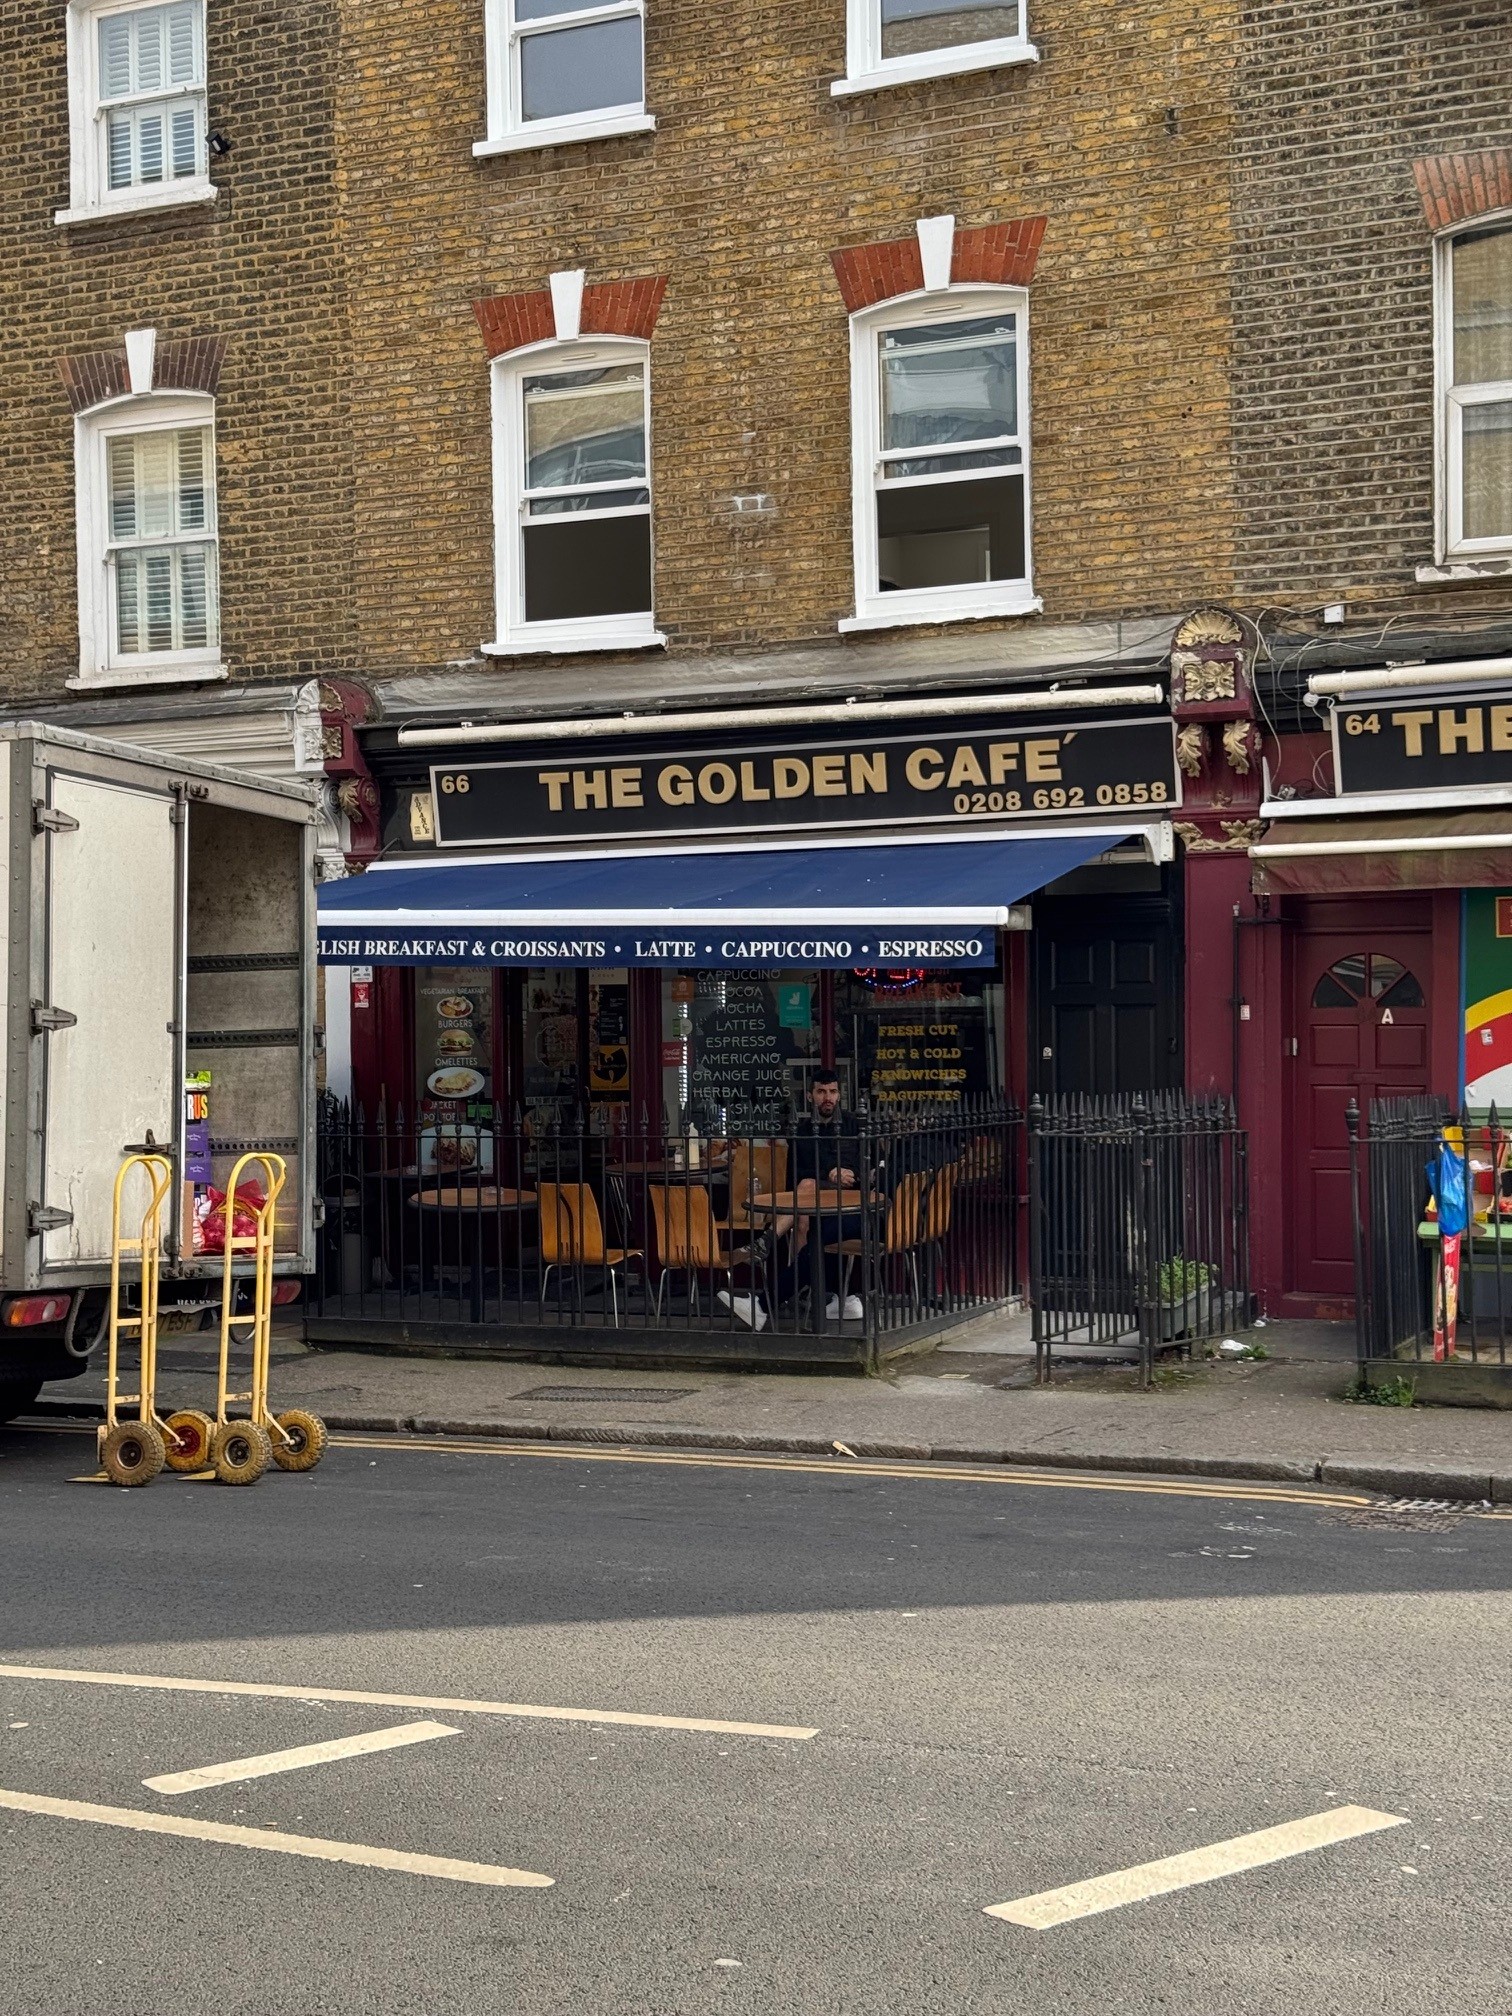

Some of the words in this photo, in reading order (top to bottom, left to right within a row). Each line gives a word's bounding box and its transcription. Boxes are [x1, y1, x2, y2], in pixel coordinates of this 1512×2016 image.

[1345, 713, 1381, 736] 64
[441, 774, 470, 794] 66
[538, 767, 644, 812] THE
[657, 750, 888, 807] GOLDEN
[953, 791, 1021, 814] 0208
[1032, 786, 1085, 809] 692
[1095, 781, 1168, 806] 0858
[317, 939, 360, 956] LISH
[364, 939, 468, 956] BREAKFAST
[471, 940, 486, 956] &
[490, 940, 606, 958] CROISSANTS
[634, 941, 697, 959] LATTE
[720, 940, 852, 959] CAPPUCCINO
[878, 938, 983, 958] ESPRESSO
[697, 968, 783, 981] CAPPUCCINO
[724, 986, 764, 998] OCOA
[1381, 1008, 1394, 1025] A
[437, 1019, 474, 1029] BURGERS
[716, 1019, 766, 1032] LATTES
[879, 1025, 925, 1037] FRESH
[928, 1024, 958, 1036] CUT
[706, 1035, 777, 1048] ESPRESSO
[700, 1053, 782, 1065] AMERICANO
[876, 1047, 906, 1060] HOT
[923, 1047, 962, 1059] COLD
[434, 1057, 478, 1066] OMELETTES
[692, 1069, 750, 1082] ORANGE
[755, 1069, 792, 1081] JUICE
[871, 1068, 968, 1081] SANDWICHES
[692, 1086, 748, 1099] HERBAL
[755, 1085, 791, 1098] TEAS
[878, 1090, 962, 1102] BAGUETTES
